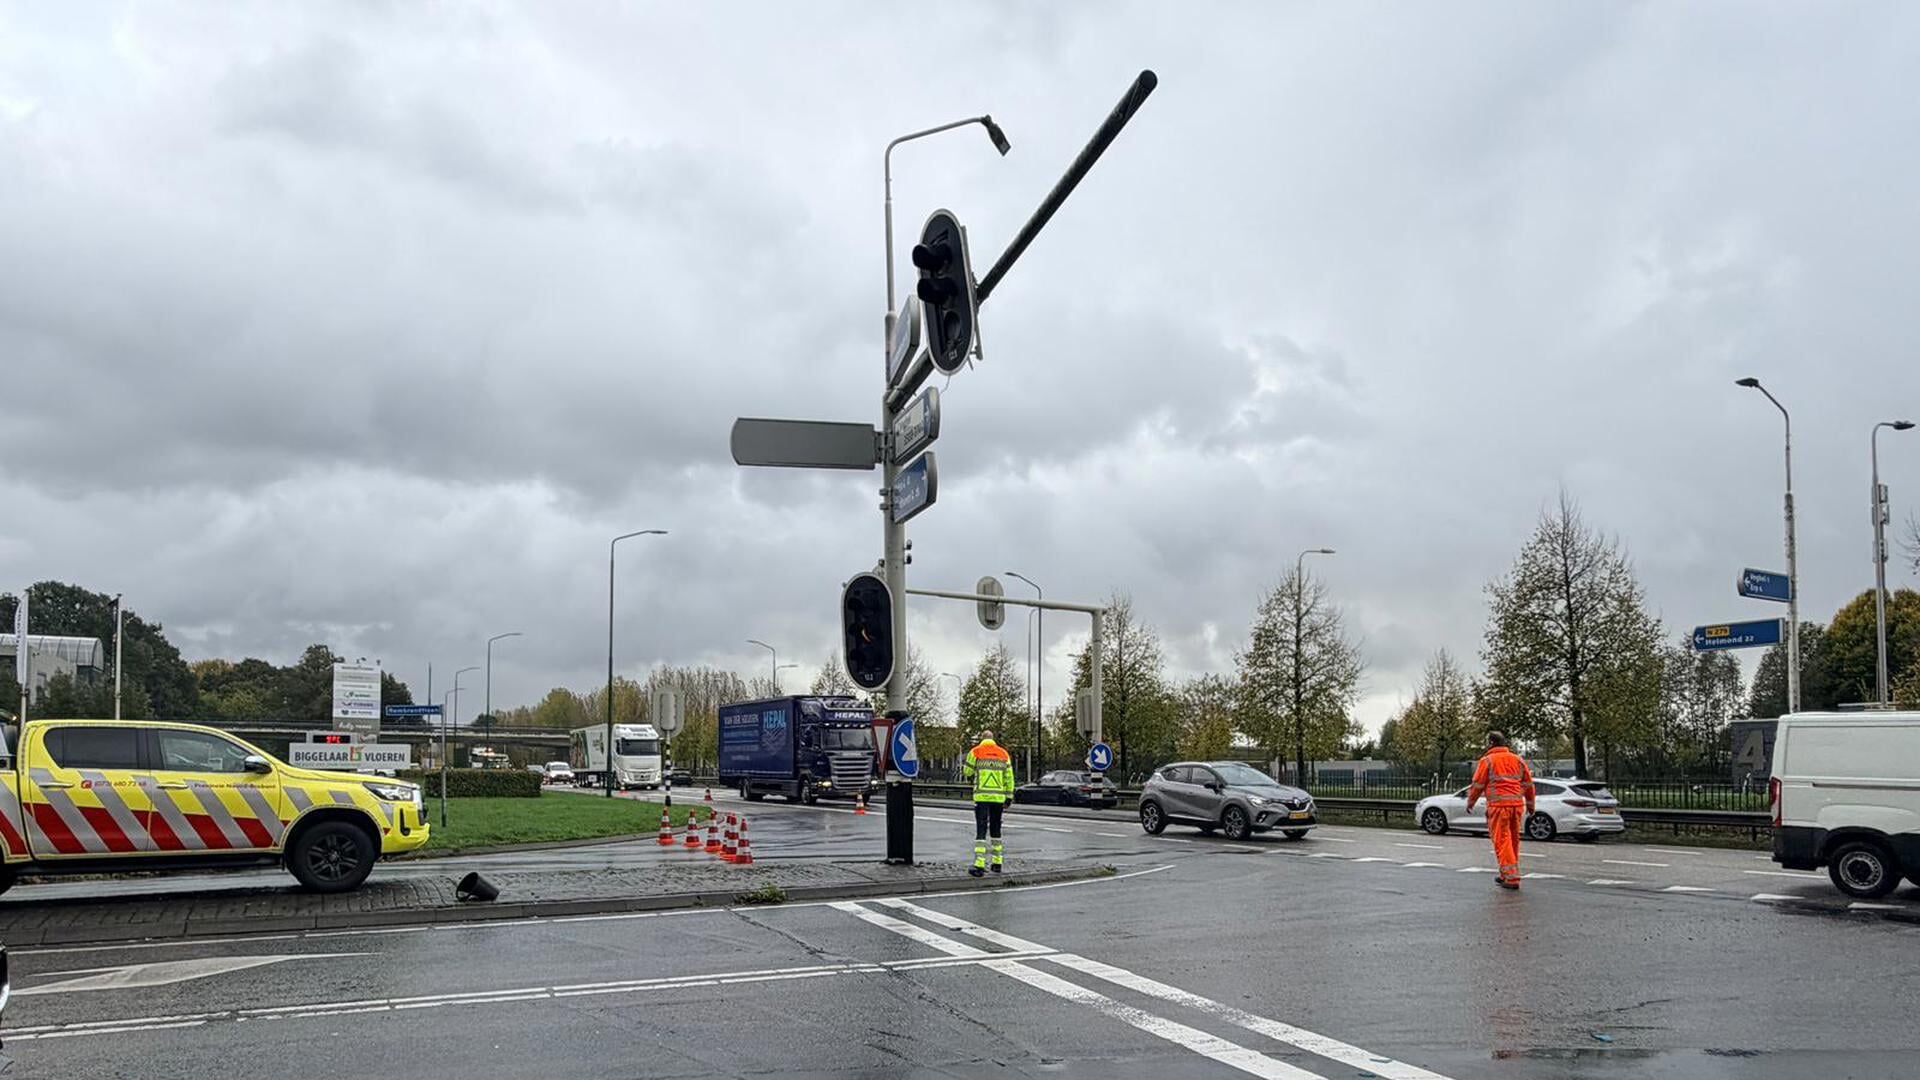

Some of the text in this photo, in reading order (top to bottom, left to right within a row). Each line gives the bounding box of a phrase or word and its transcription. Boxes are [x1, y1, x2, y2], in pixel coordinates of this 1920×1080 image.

[1713, 628, 1727, 636] 279
[1705, 634, 1755, 646] Helmond 22
[763, 709, 787, 729] HEPAL
[834, 711, 866, 719] HEPAL
[1737, 729, 1764, 771] 4
[294, 751, 405, 762] BIGGELAAR VLOEREN
